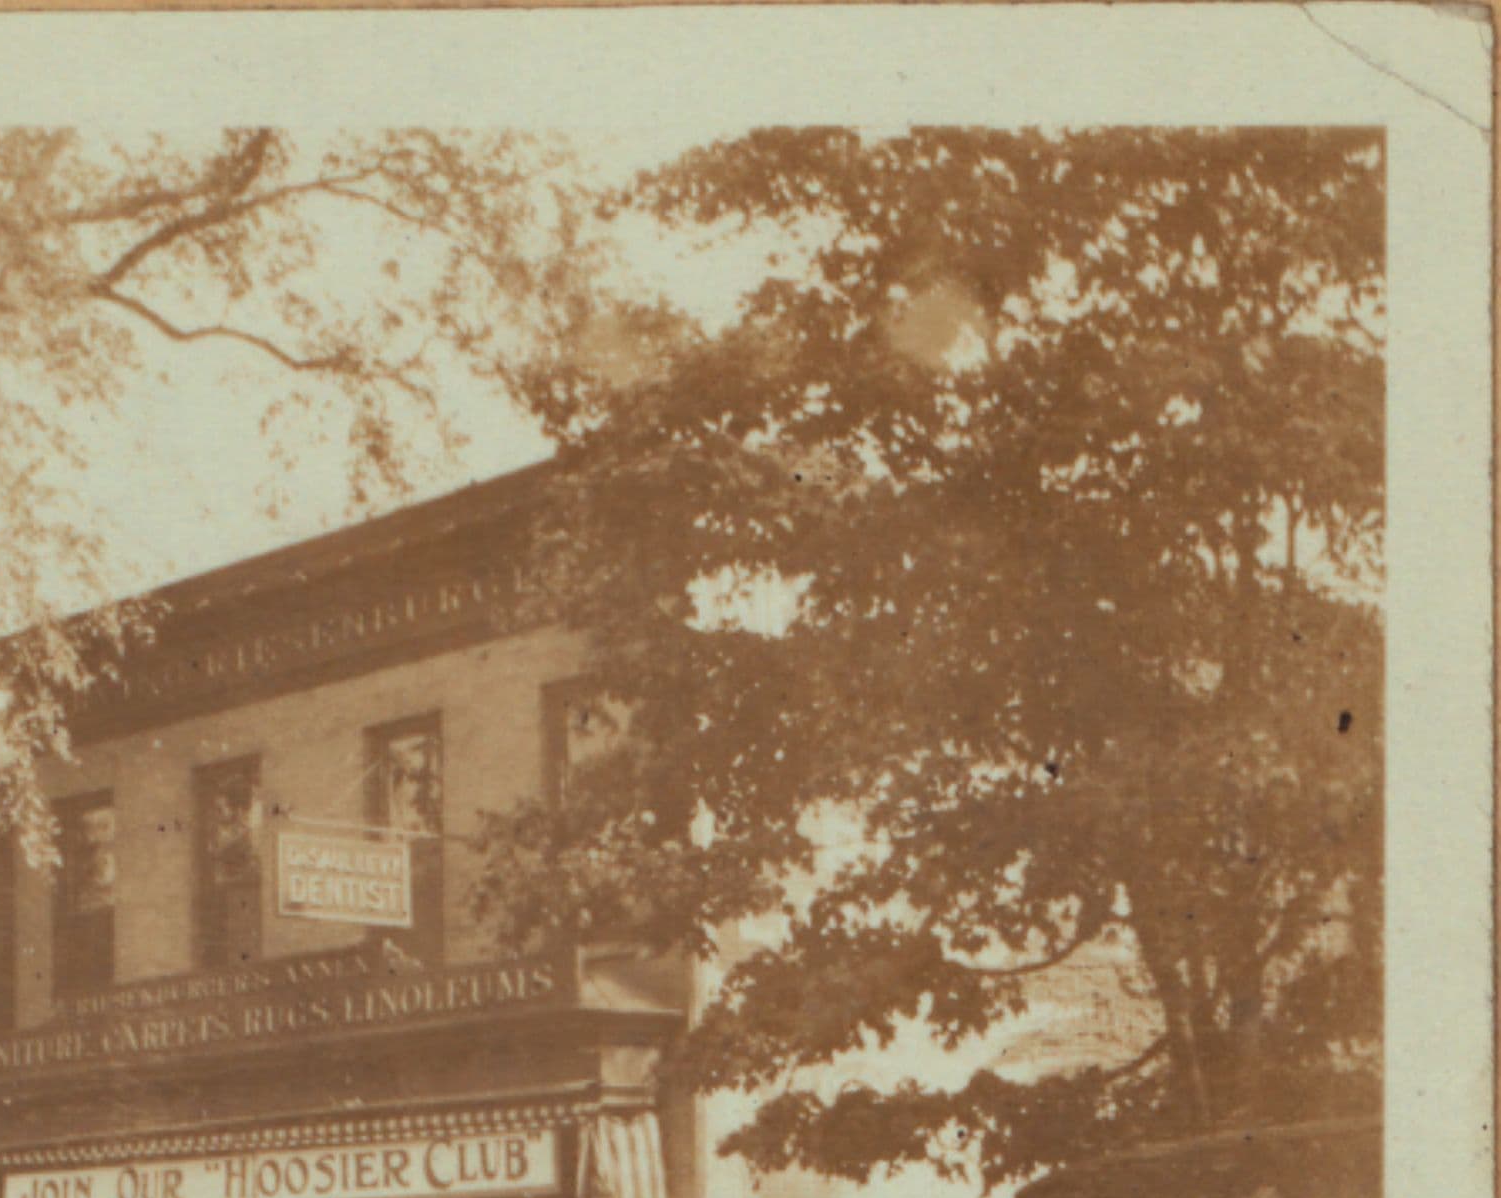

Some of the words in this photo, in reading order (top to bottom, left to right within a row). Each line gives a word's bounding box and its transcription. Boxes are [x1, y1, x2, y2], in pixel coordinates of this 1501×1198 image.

[289, 873, 404, 914] DENTIST
[101, 1014, 229, 1054] CARPETS
[243, 998, 331, 1035] RUGS
[344, 963, 554, 1024] LINOLEUMS
[421, 1127, 542, 1191] CLUB"
